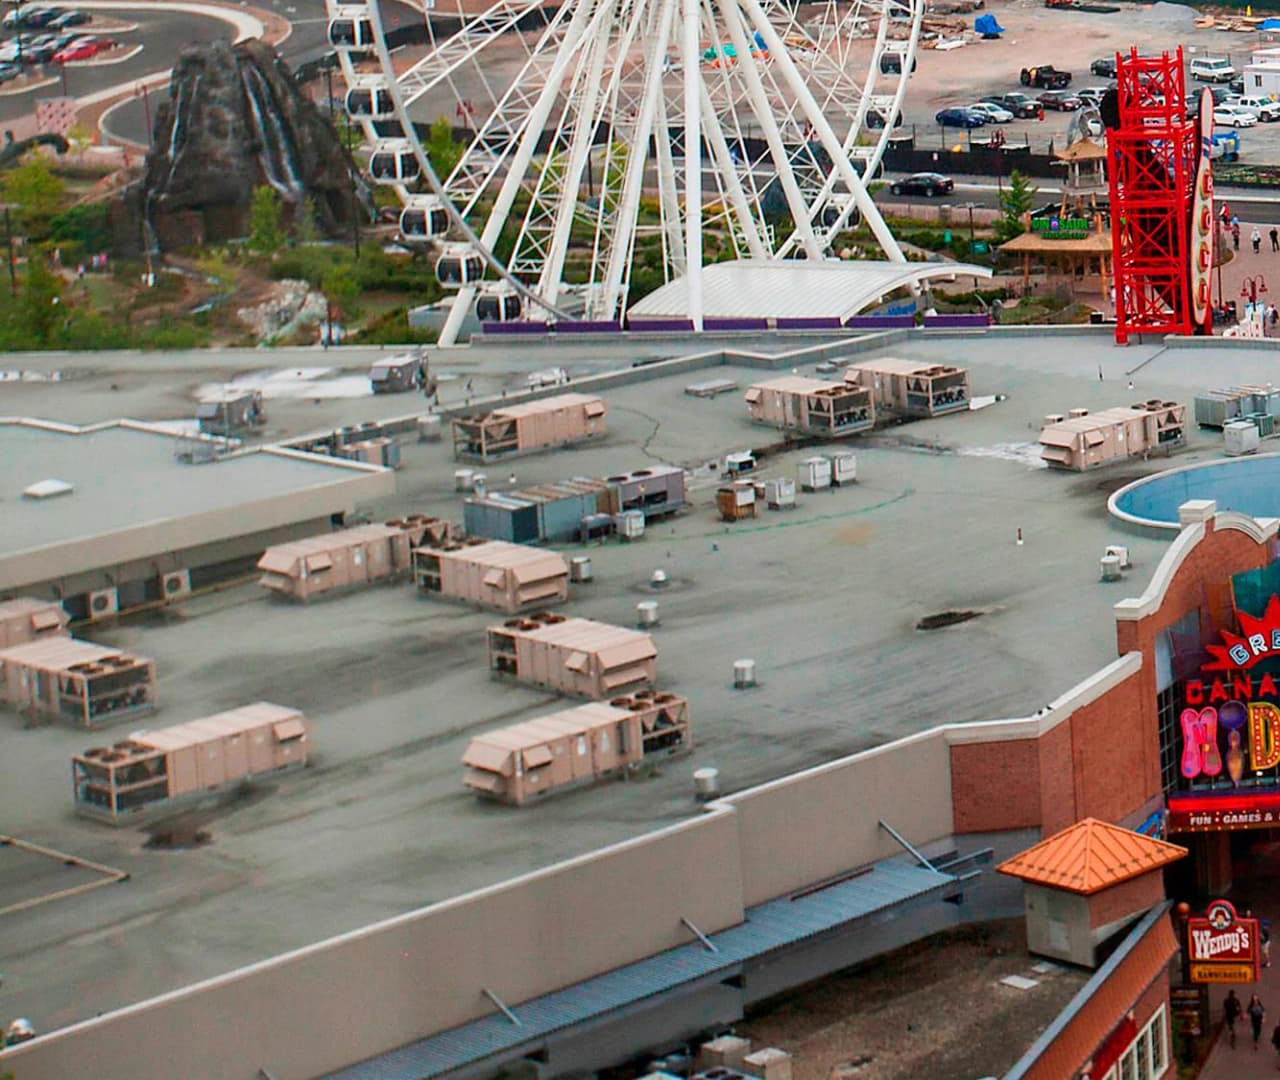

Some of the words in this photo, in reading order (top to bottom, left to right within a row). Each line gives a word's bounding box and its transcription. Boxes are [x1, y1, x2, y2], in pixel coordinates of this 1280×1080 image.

[1190, 815, 1212, 825] FUN
[1223, 812, 1261, 824] GAMES
[1264, 812, 1273, 821] &
[1192, 926, 1249, 959] Wendy's
